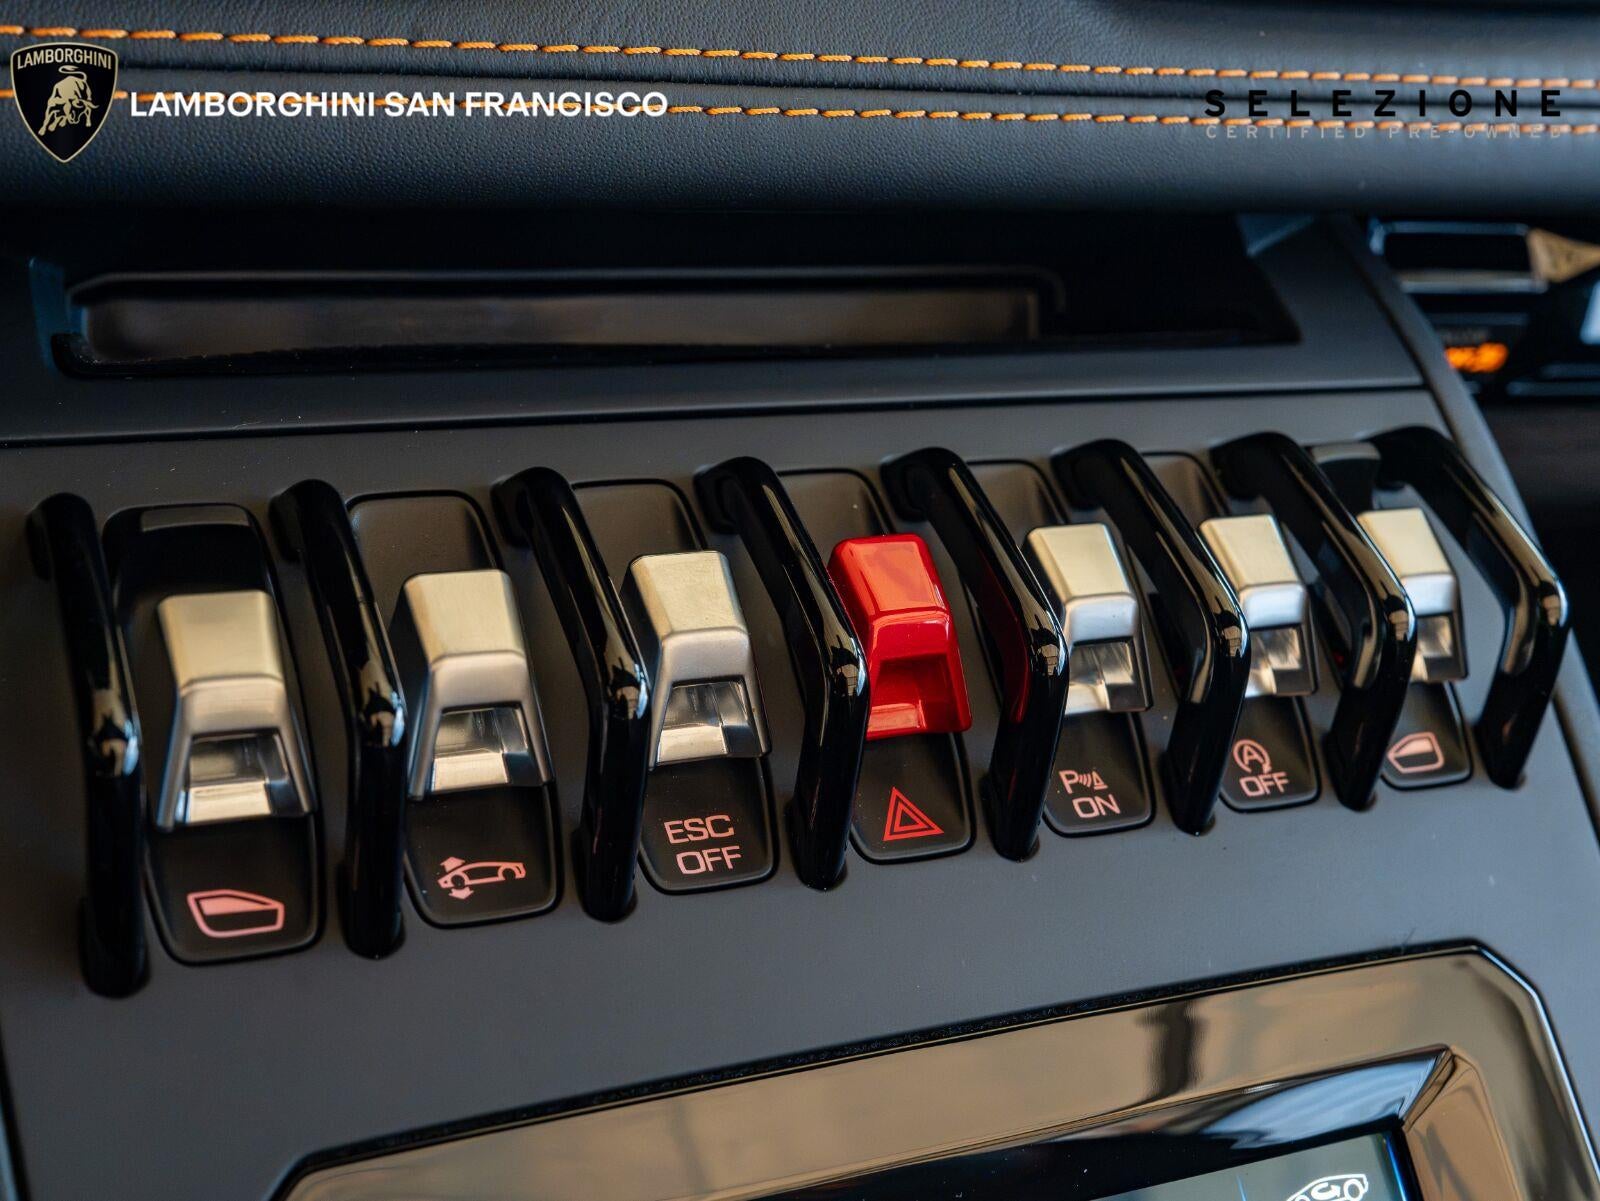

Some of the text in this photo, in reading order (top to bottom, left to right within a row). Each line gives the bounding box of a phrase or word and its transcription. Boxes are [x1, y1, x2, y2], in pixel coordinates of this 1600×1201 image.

[1239, 772, 1288, 797] OFF
[1072, 794, 1120, 818] ON
[664, 814, 735, 844] ESC
[675, 845, 741, 874] OFF
